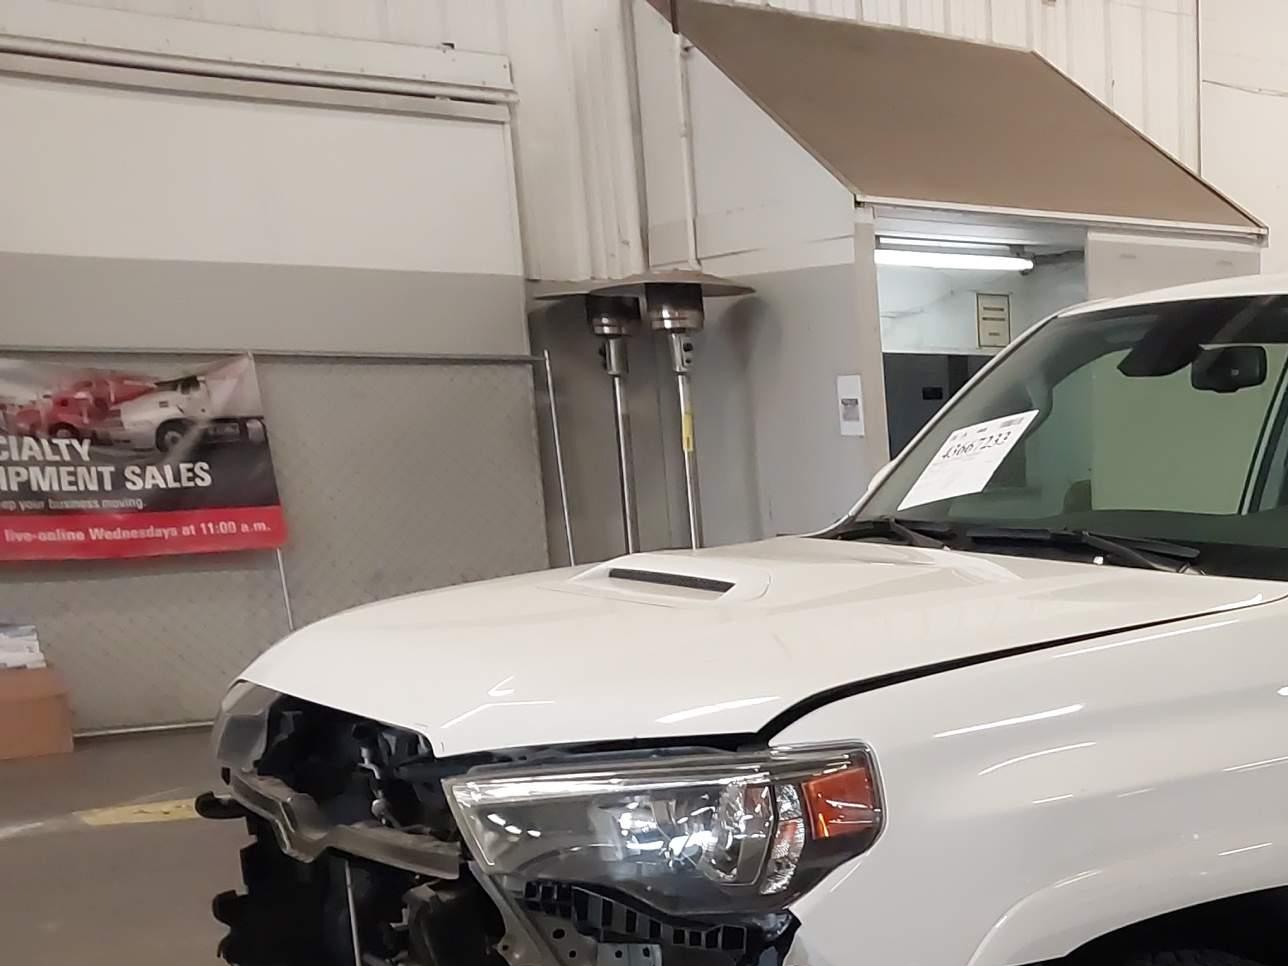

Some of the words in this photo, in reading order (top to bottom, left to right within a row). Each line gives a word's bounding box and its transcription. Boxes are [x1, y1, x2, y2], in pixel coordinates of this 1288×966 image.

[123, 461, 213, 491] SALES
[48, 498, 100, 510] business
[4, 528, 86, 542] live-online
[88, 525, 179, 540] Wednesdays
[181, 524, 197, 536] at
[199, 521, 238, 535] 11:00
[240, 520, 272, 533] a.m.
